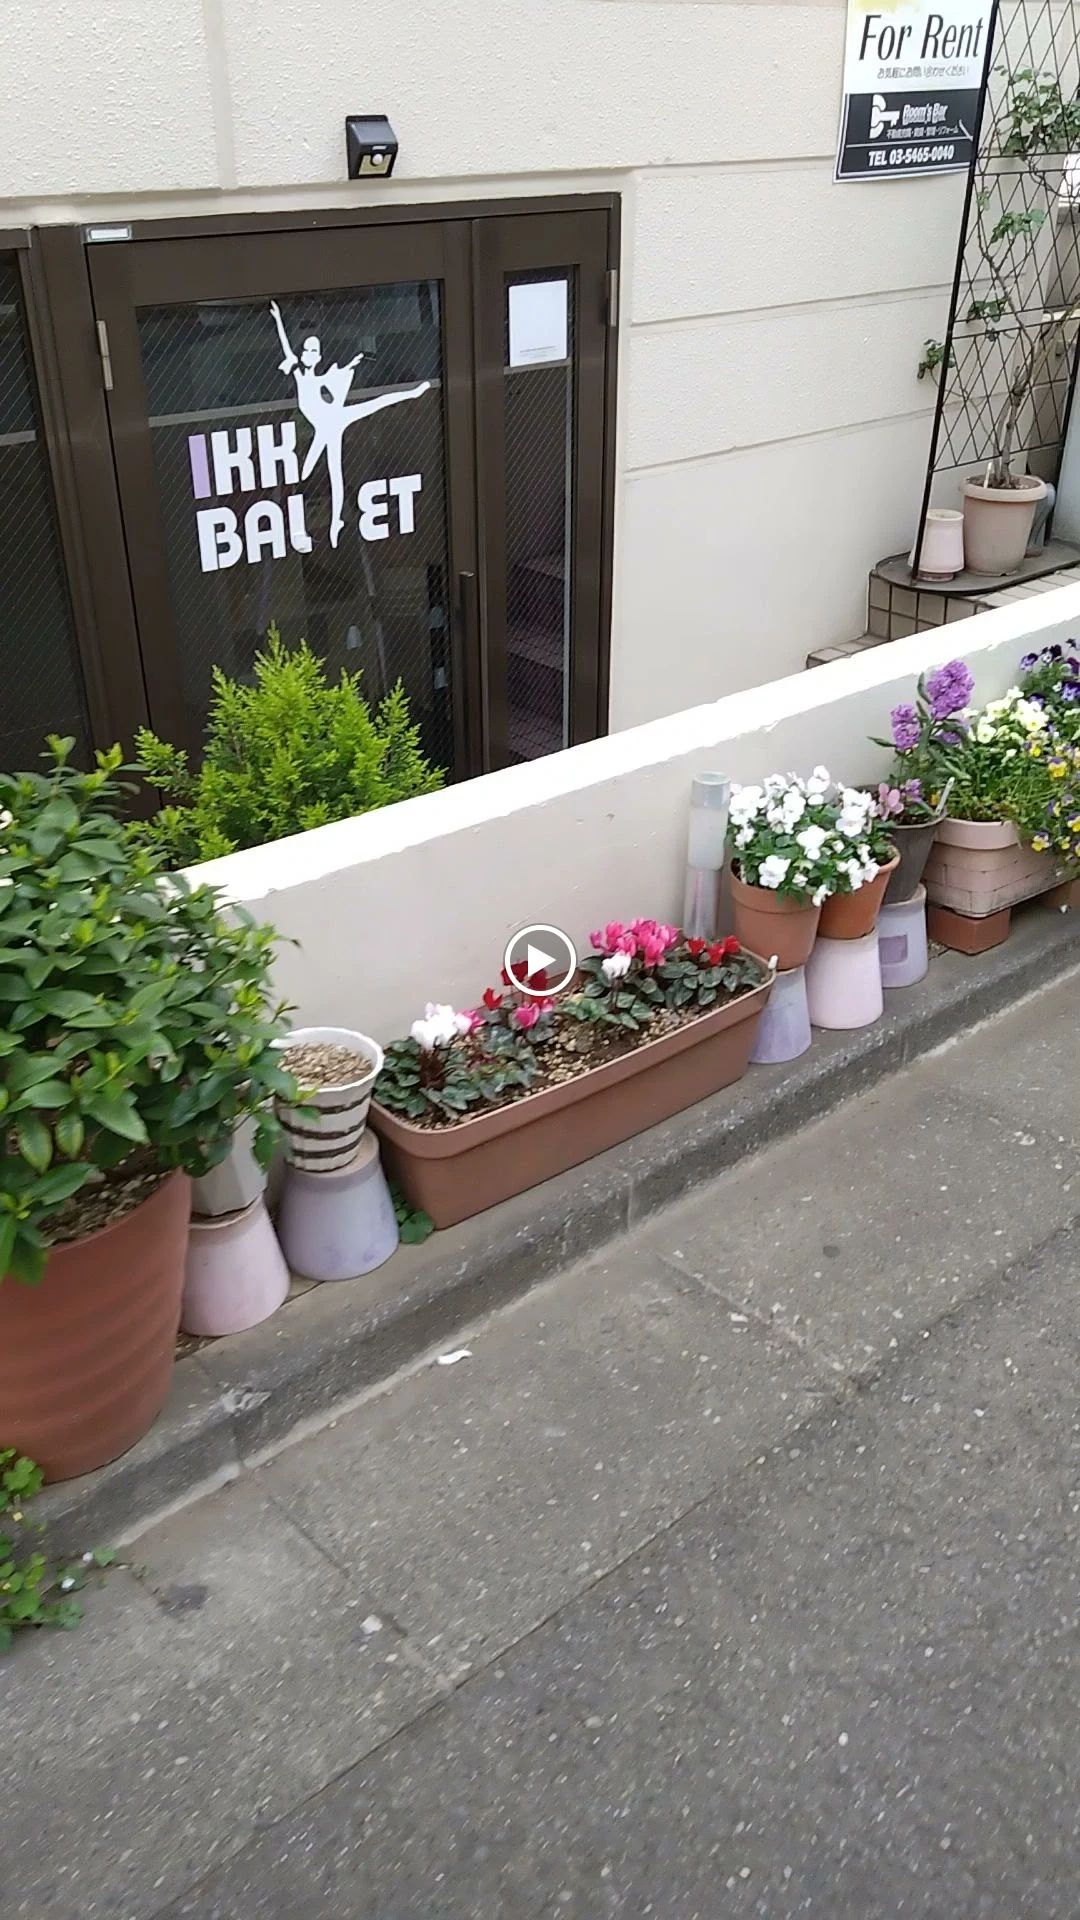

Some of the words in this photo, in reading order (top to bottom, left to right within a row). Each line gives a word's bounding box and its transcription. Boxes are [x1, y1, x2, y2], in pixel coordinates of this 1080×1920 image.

[859, 14, 913, 61] For
[920, 14, 984, 59] Rent
[902, 103, 932, 126] Room's
[868, 150, 888, 167] TEL
[889, 144, 955, 165] 03-5465-0040
